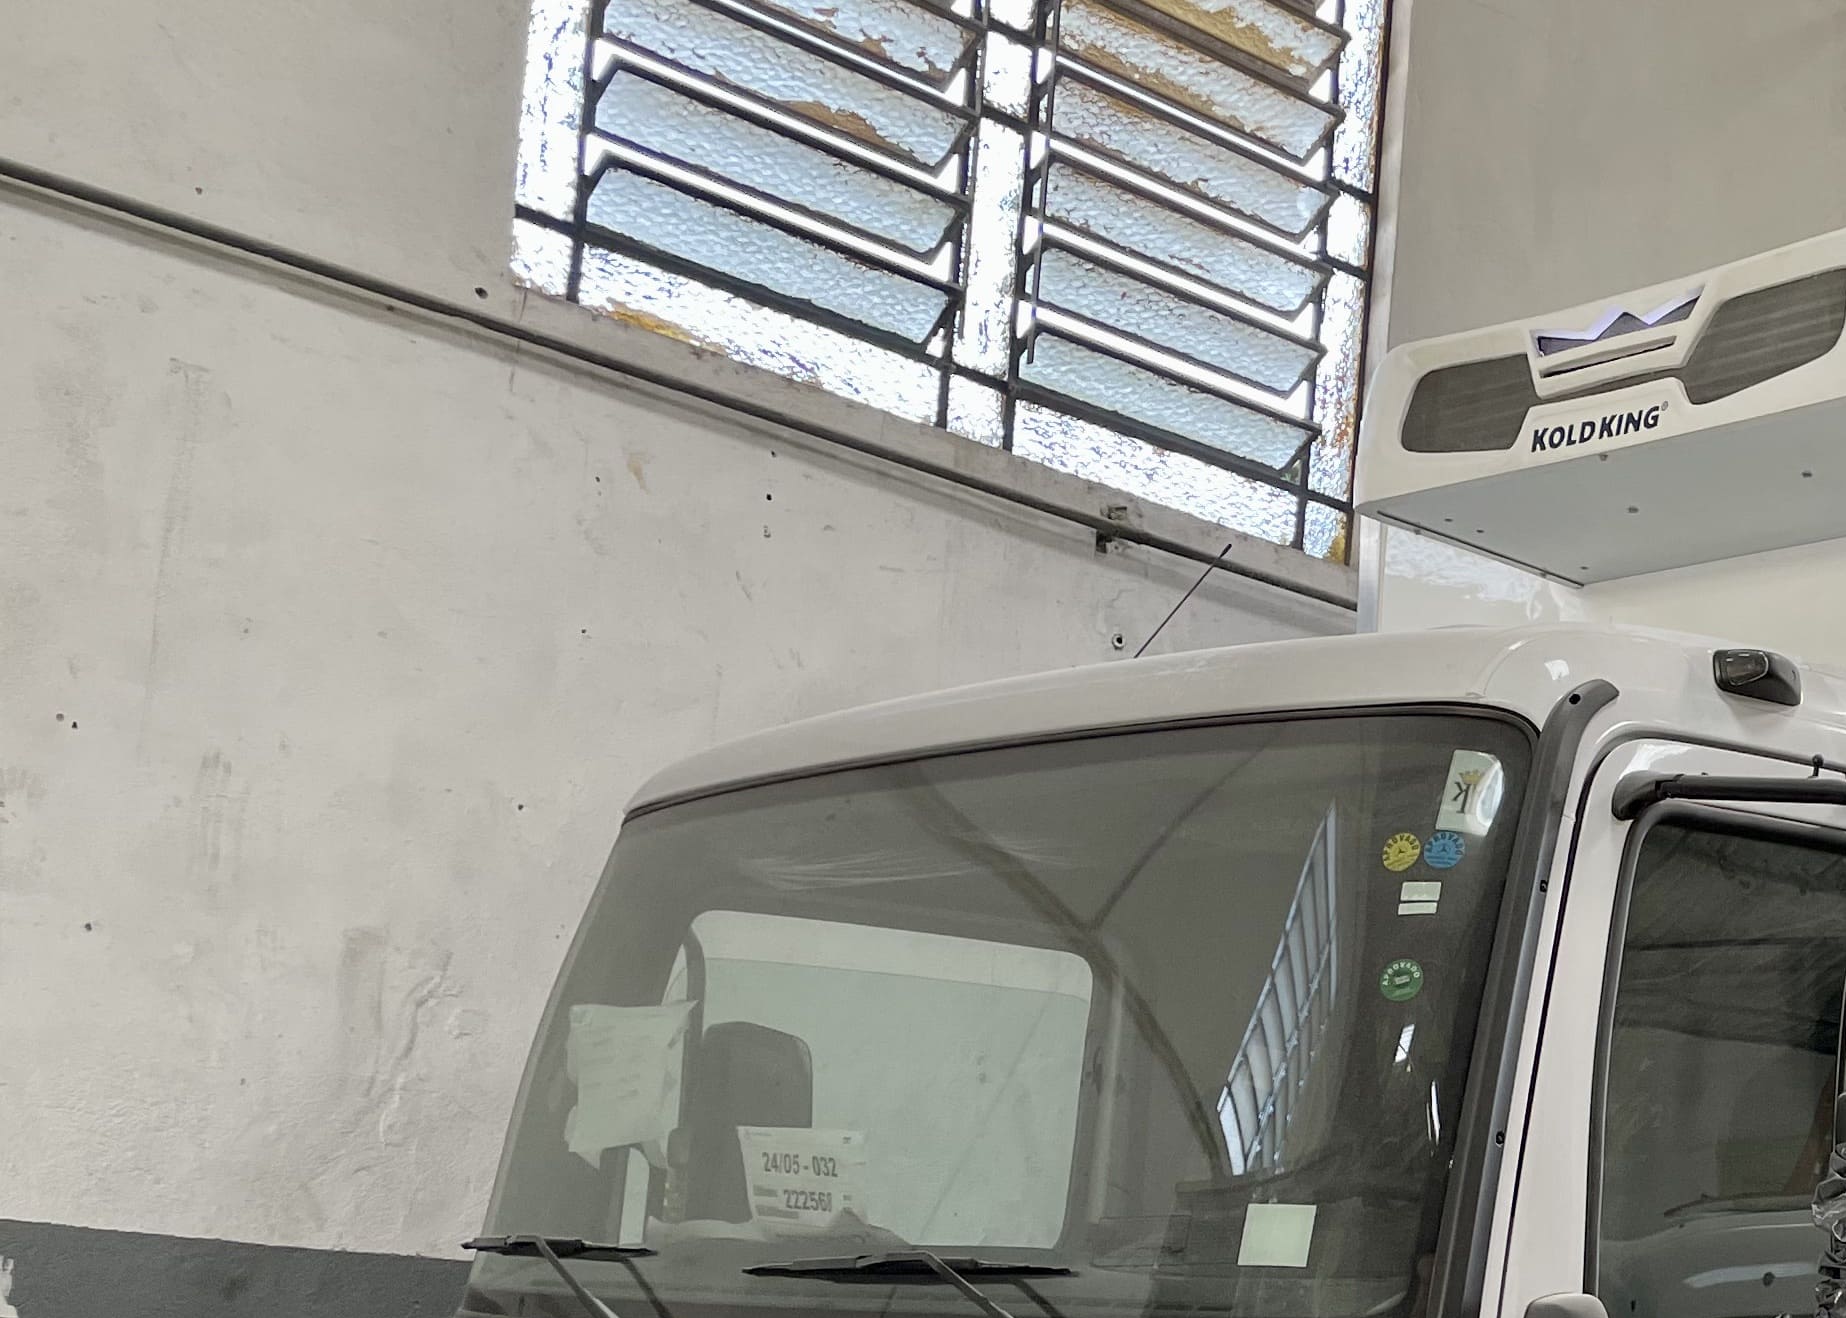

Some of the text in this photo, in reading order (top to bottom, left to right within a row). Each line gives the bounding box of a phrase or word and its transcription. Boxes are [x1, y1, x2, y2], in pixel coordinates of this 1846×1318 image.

[1531, 405, 1660, 452] KOLD KING
[1382, 961, 1421, 987] APROVADO
[762, 1151, 800, 1175] 24/05
[812, 1155, 838, 1178] 032
